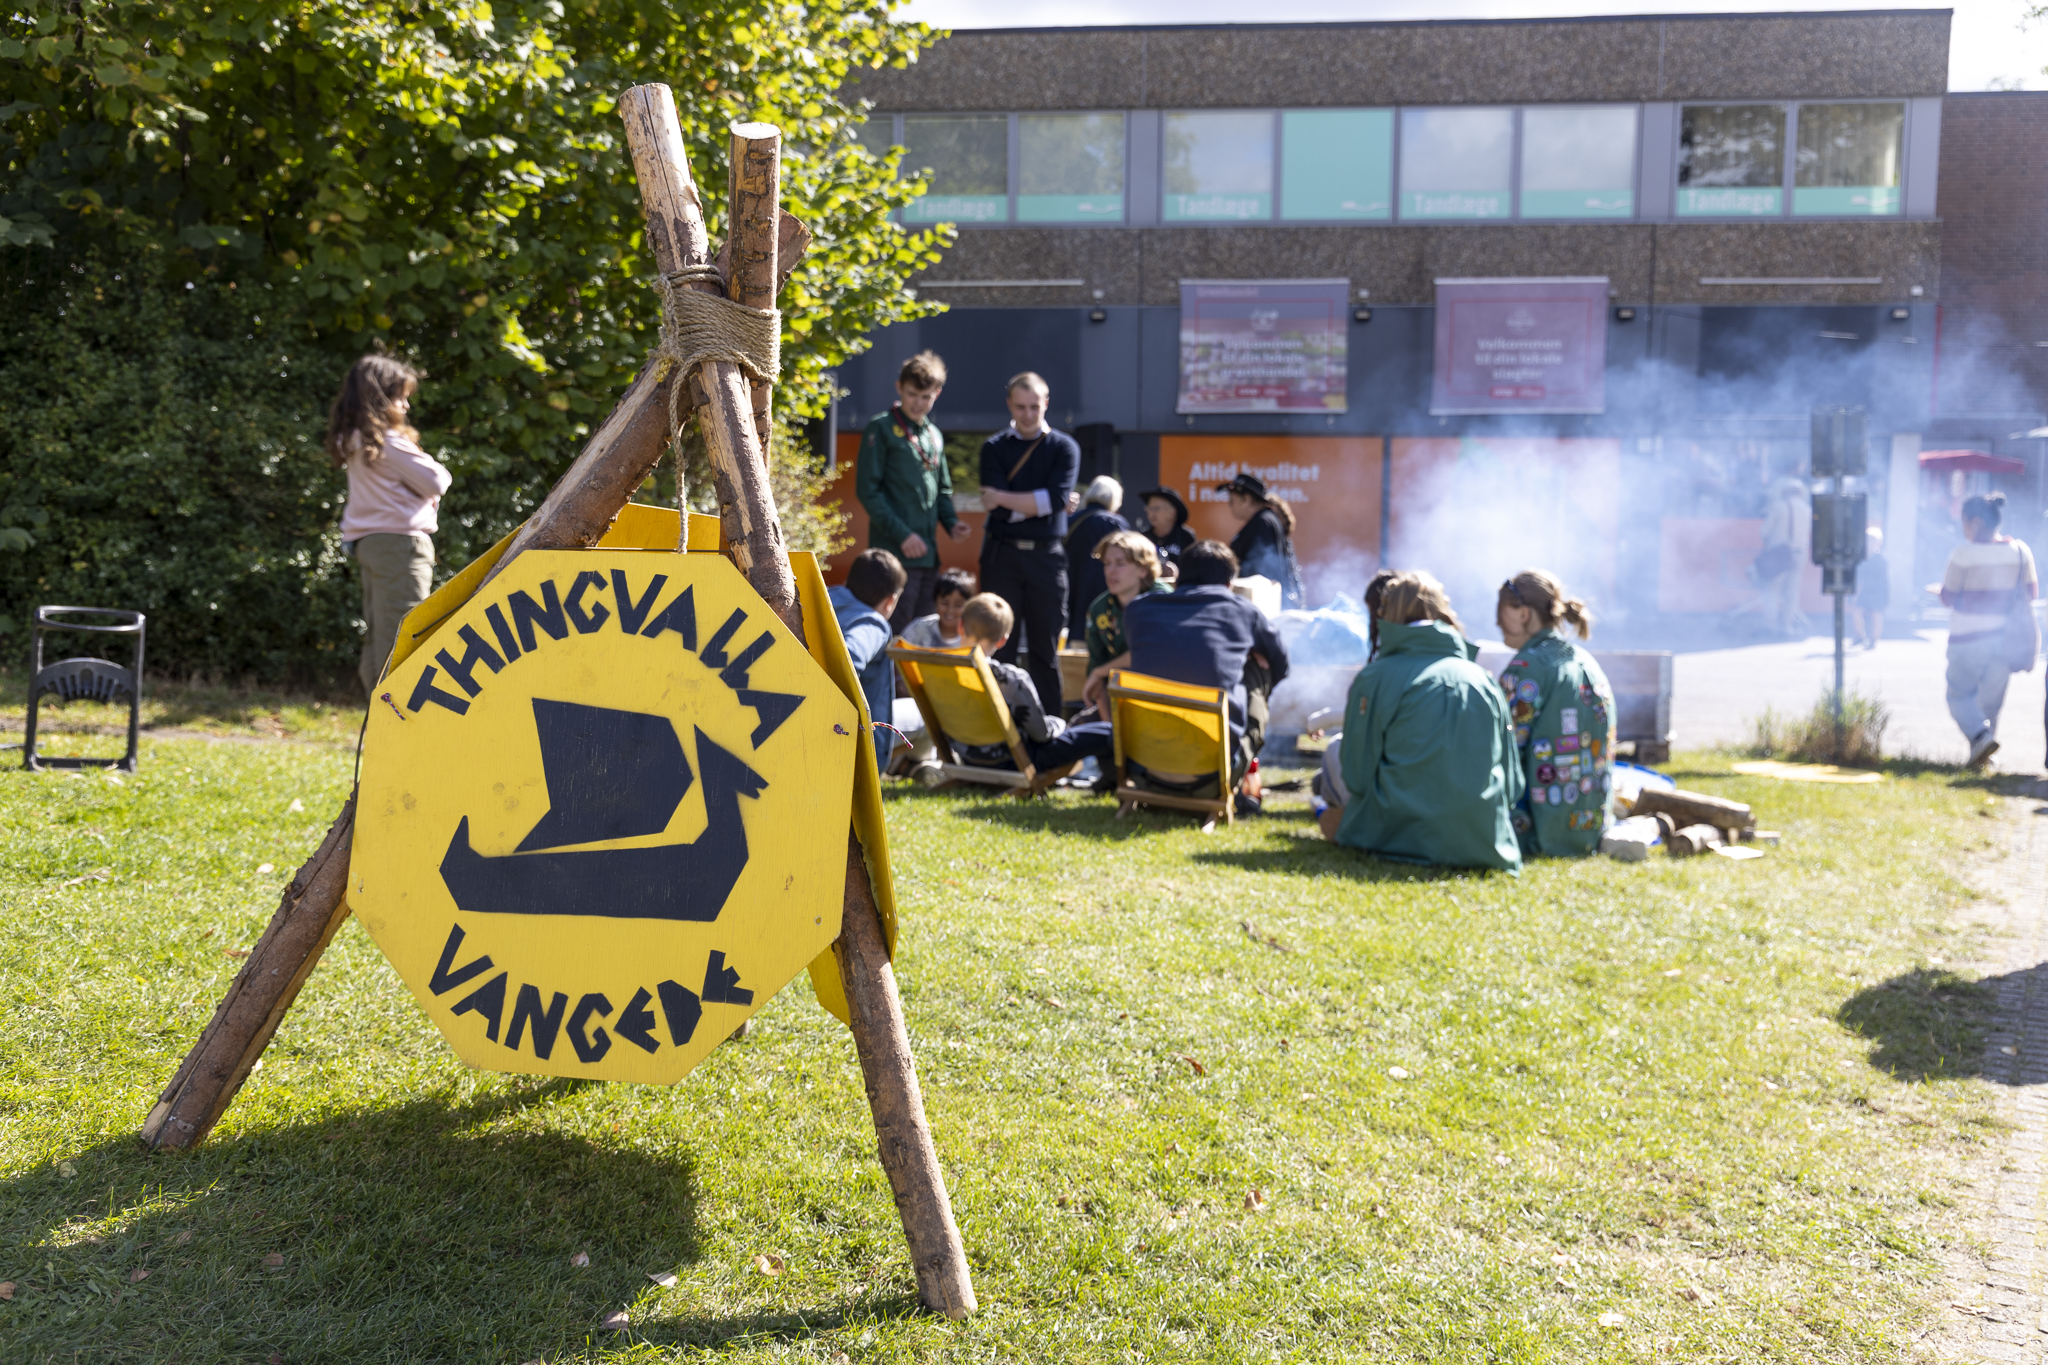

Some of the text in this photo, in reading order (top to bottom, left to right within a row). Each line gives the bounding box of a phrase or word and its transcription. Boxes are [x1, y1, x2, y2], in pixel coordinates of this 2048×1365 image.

[917, 197, 997, 221] Tandlæge
[1177, 195, 1260, 219] Tandlæge
[1686, 189, 1775, 214] Tandlæge
[1476, 337, 1562, 350] Velkommen
[1189, 461, 1319, 482] Altid kvalitet
[1189, 482, 1197, 502] i
[407, 568, 807, 751] THINGVALLA
[428, 922, 754, 1063] VANGEDE
